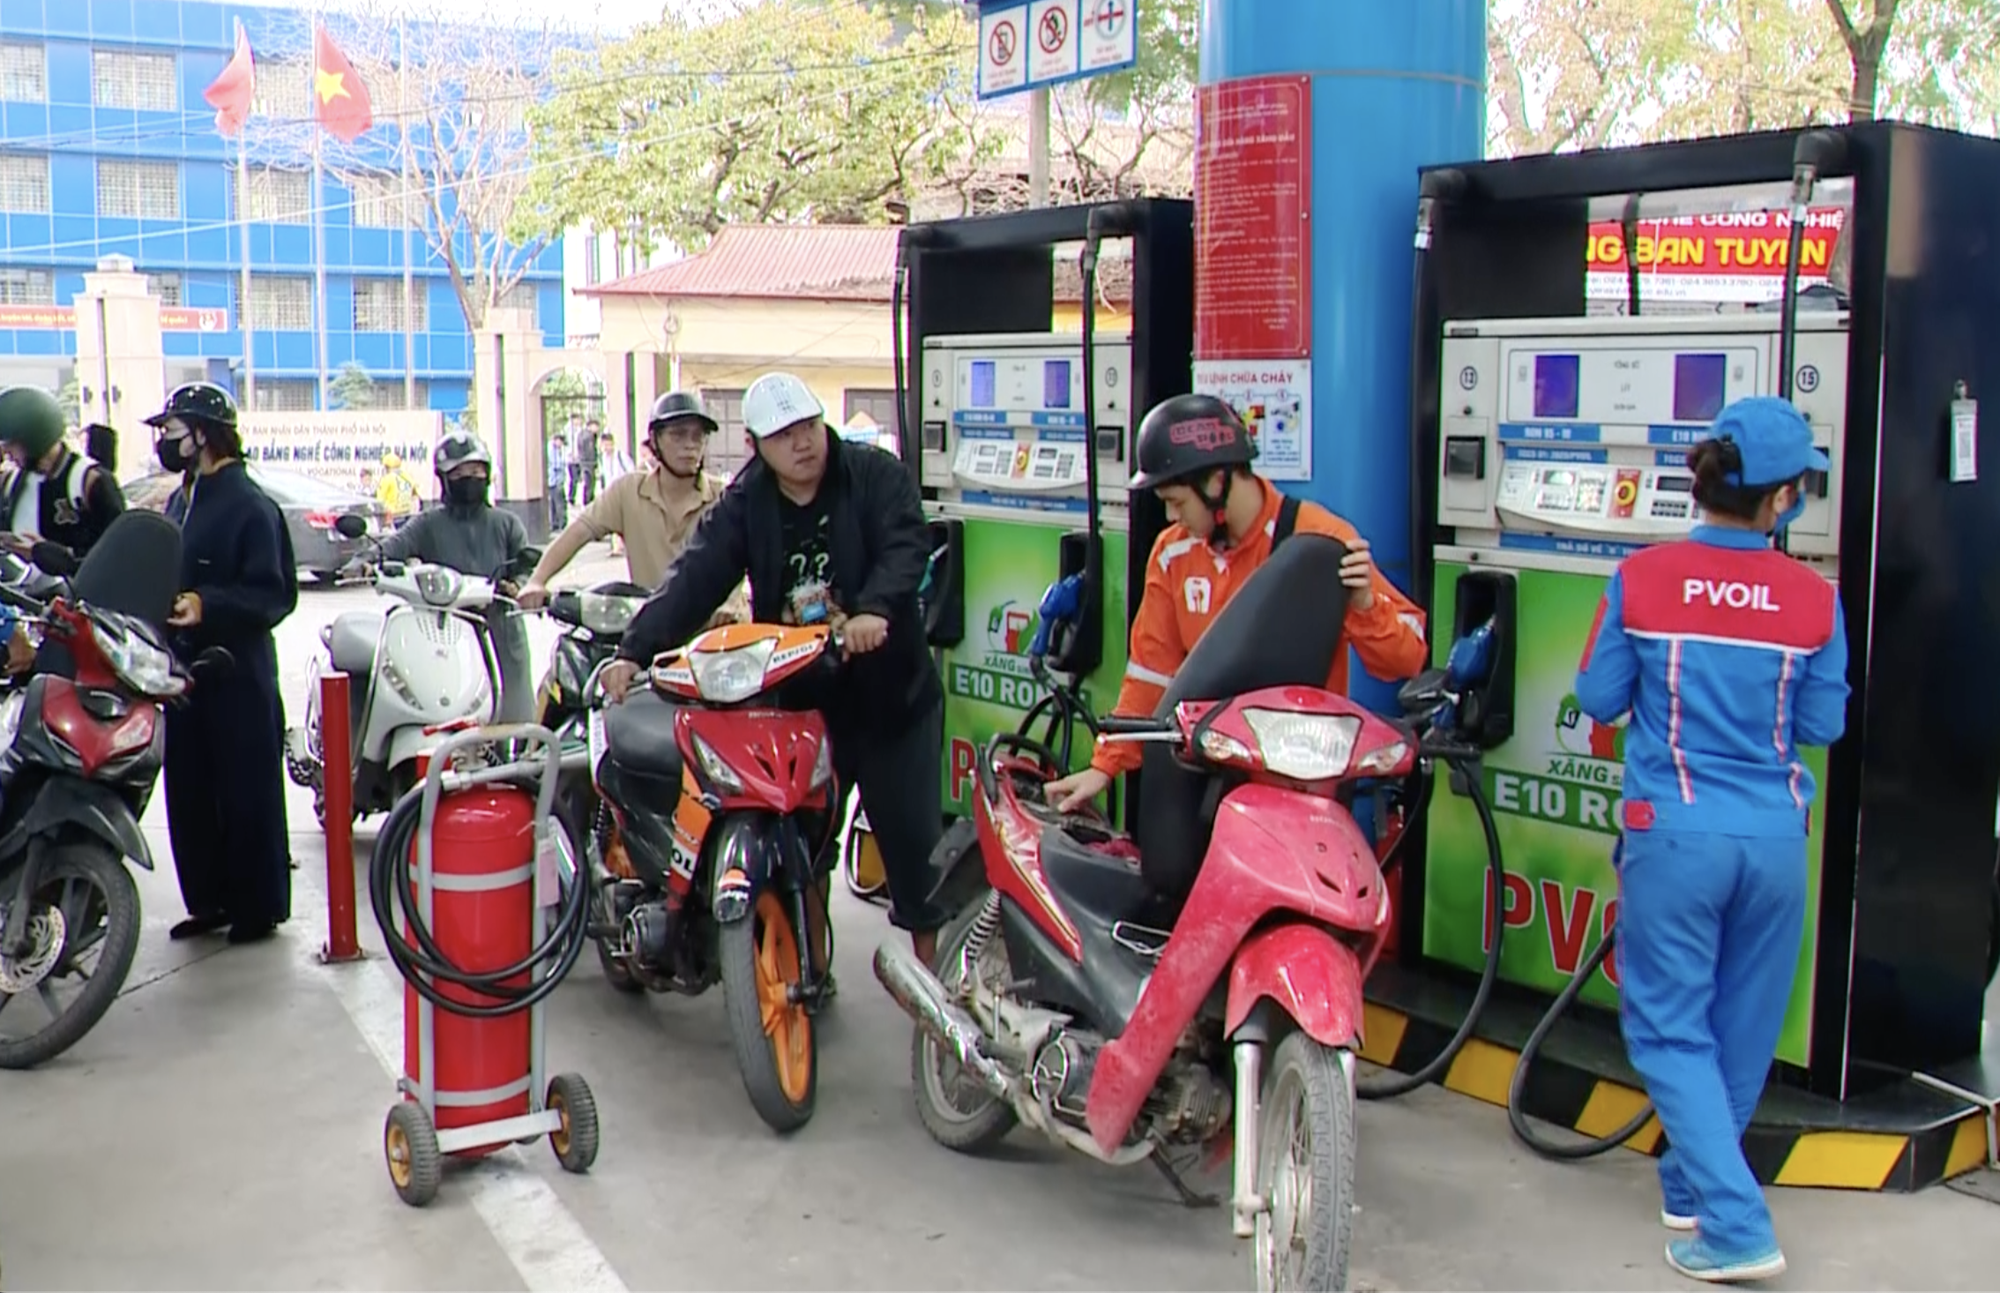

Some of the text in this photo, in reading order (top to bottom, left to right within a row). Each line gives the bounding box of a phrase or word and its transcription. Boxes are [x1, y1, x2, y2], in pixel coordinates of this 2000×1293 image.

[252, 425, 268, 435] BAN
[1682, 578, 1781, 612] PVOIL
[955, 666, 994, 700] E10
[1546, 757, 1609, 783] XĂNG
[1494, 773, 1566, 818] E10
[1484, 865, 1620, 988] PV
